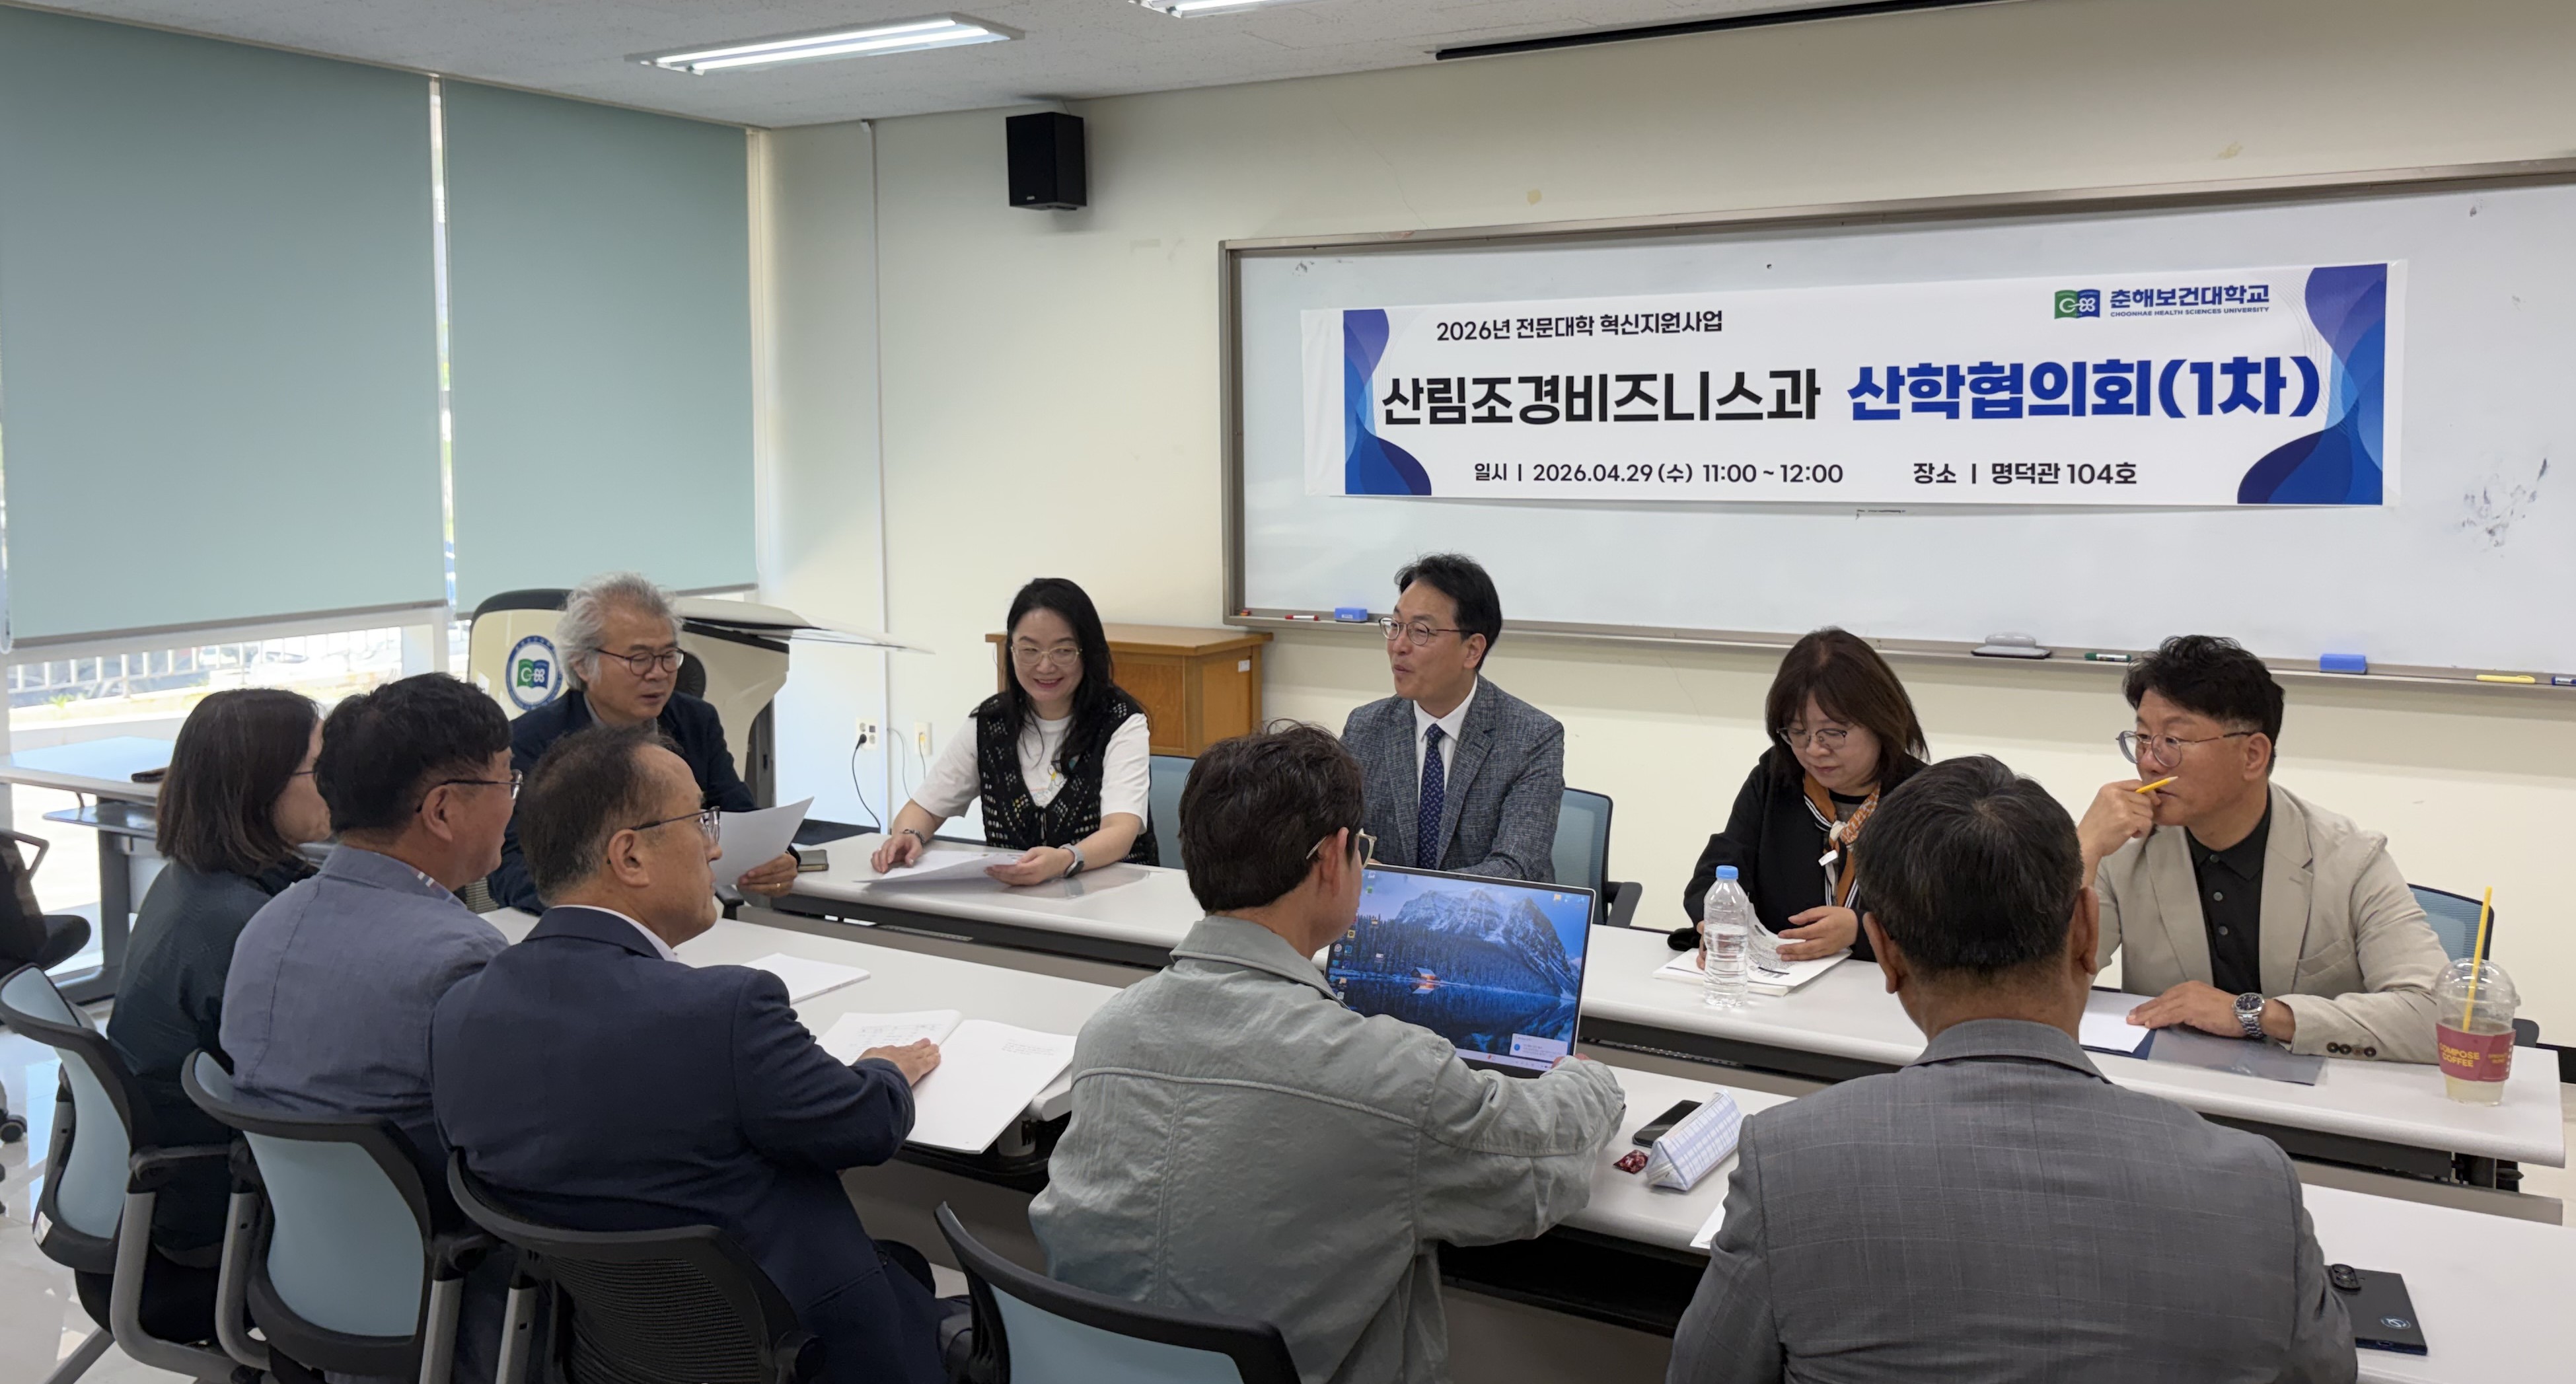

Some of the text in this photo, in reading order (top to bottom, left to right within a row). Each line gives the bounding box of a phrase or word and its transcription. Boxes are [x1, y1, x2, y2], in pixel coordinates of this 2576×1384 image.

[2110, 285, 2269, 309] 춘해보건대학교
[1436, 310, 1723, 341] 2026년 전문대학 혁신지원사업
[1382, 355, 2320, 425] 산림조경비즈니스과 산학협의회(1차)
[1474, 462, 1507, 482] 일시
[1703, 464, 1757, 483] 11:00
[1780, 464, 1843, 484] 12:00
[1913, 462, 1957, 484] 장소
[1991, 462, 2061, 484] 명덕관
[2067, 462, 2137, 485] 104호
[2443, 1052, 2474, 1068] COFFEE
